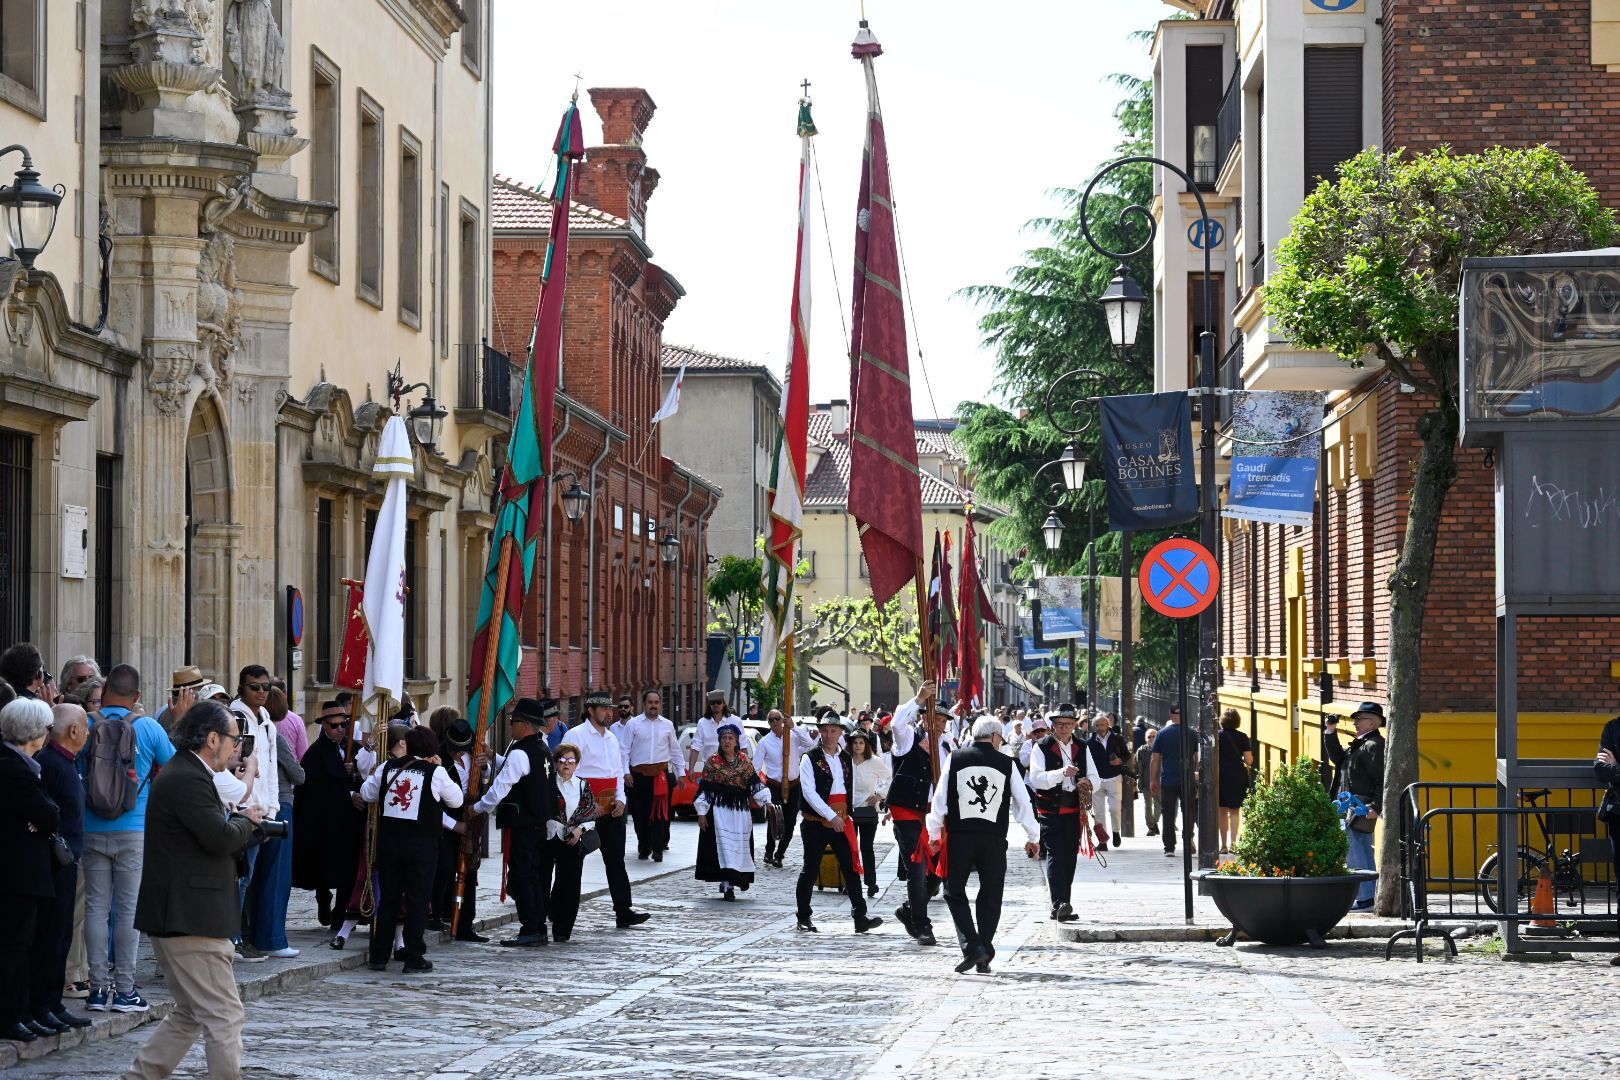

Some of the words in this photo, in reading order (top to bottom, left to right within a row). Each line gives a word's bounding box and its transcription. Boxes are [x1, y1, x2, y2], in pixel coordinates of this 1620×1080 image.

[1116, 442, 1152, 450] MUSEO
[1117, 454, 1156, 467] CASA
[1118, 463, 1182, 479] BOTINES
[1236, 463, 1267, 472] Gaudí
[1247, 473, 1291, 483] trencadís
[738, 639, 755, 660] P
